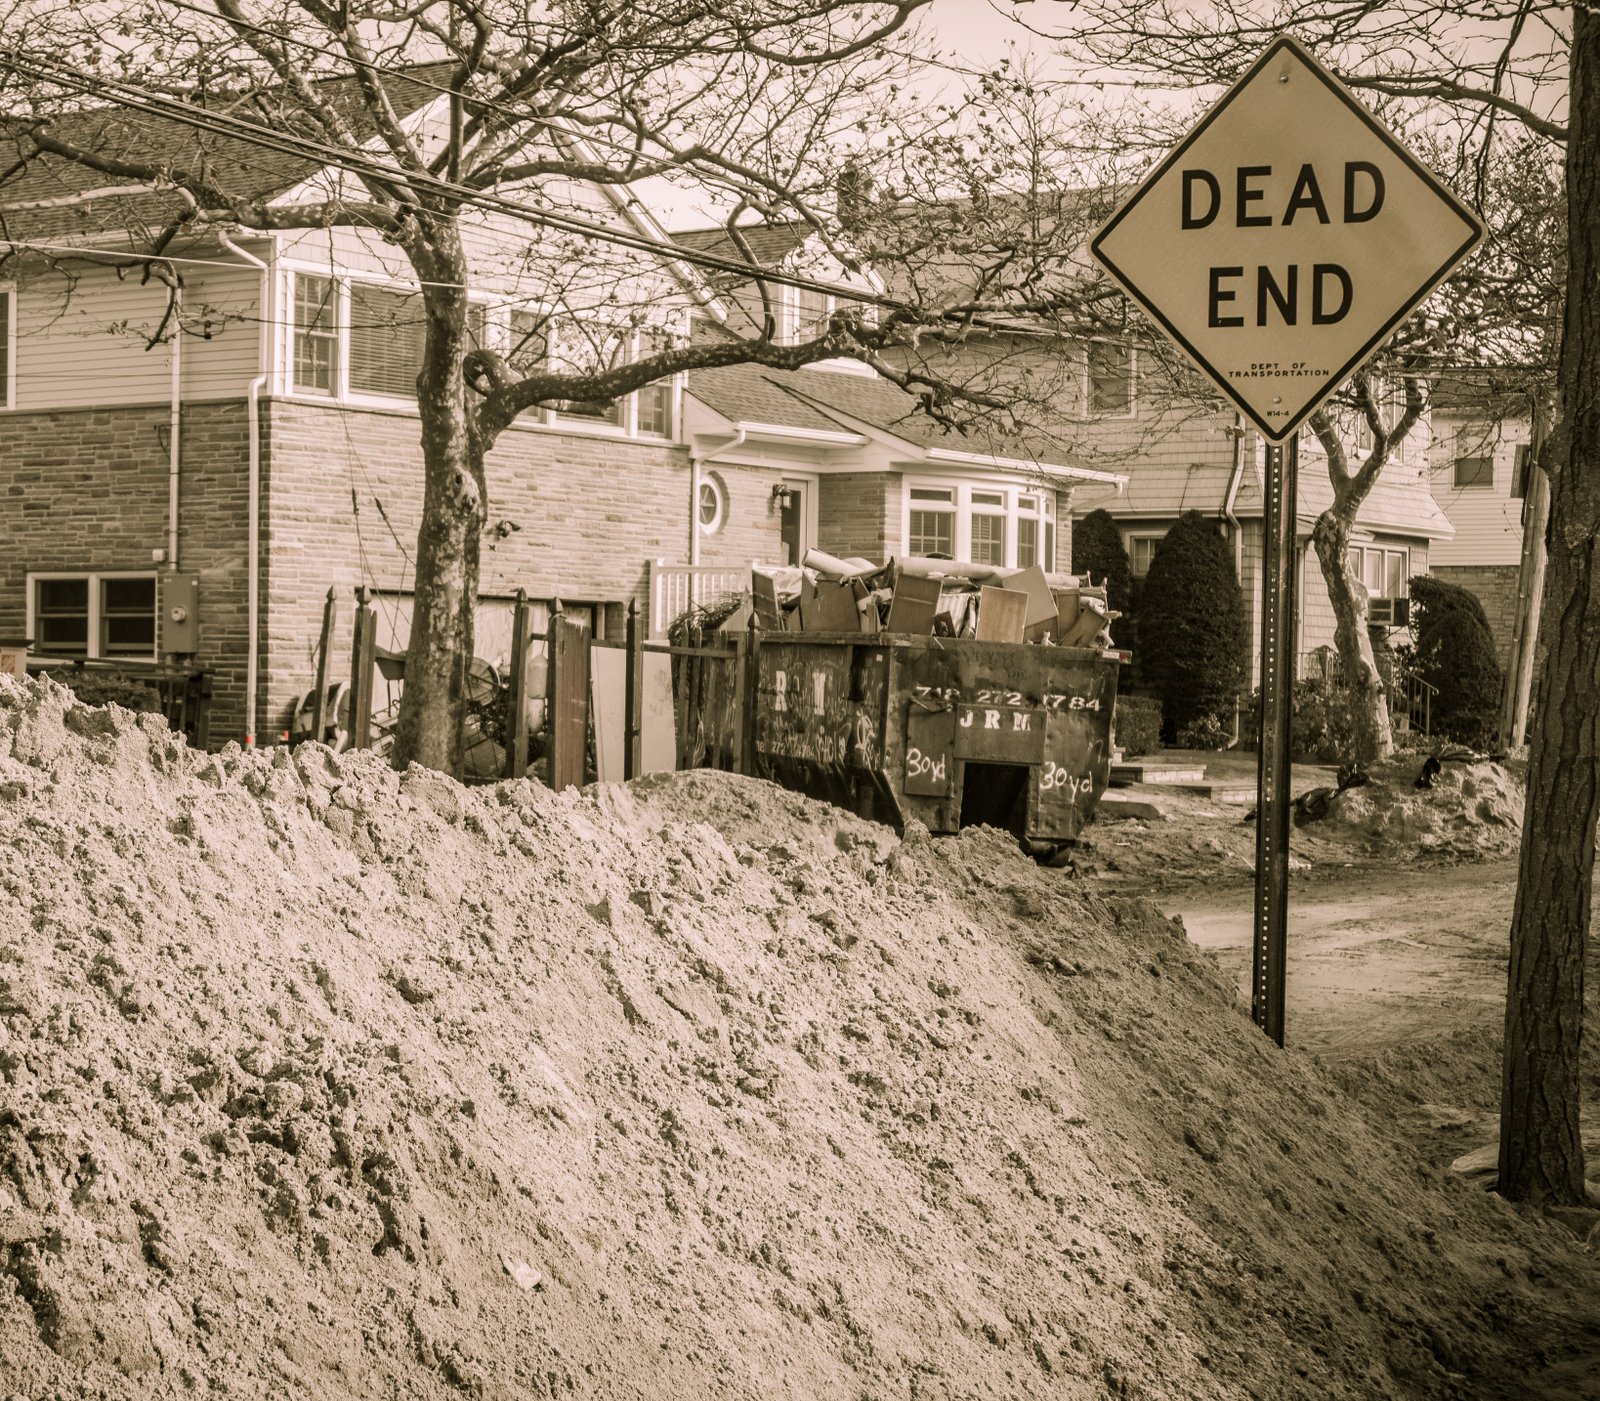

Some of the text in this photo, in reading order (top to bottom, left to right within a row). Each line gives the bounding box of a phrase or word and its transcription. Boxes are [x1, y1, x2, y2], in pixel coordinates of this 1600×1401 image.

[1182, 161, 1385, 229] DEAD
[1208, 263, 1353, 327] END
[1229, 369, 1329, 377] TRANSPORTATION
[977, 689, 1022, 706] 272
[1043, 693, 1100, 711] 1784
